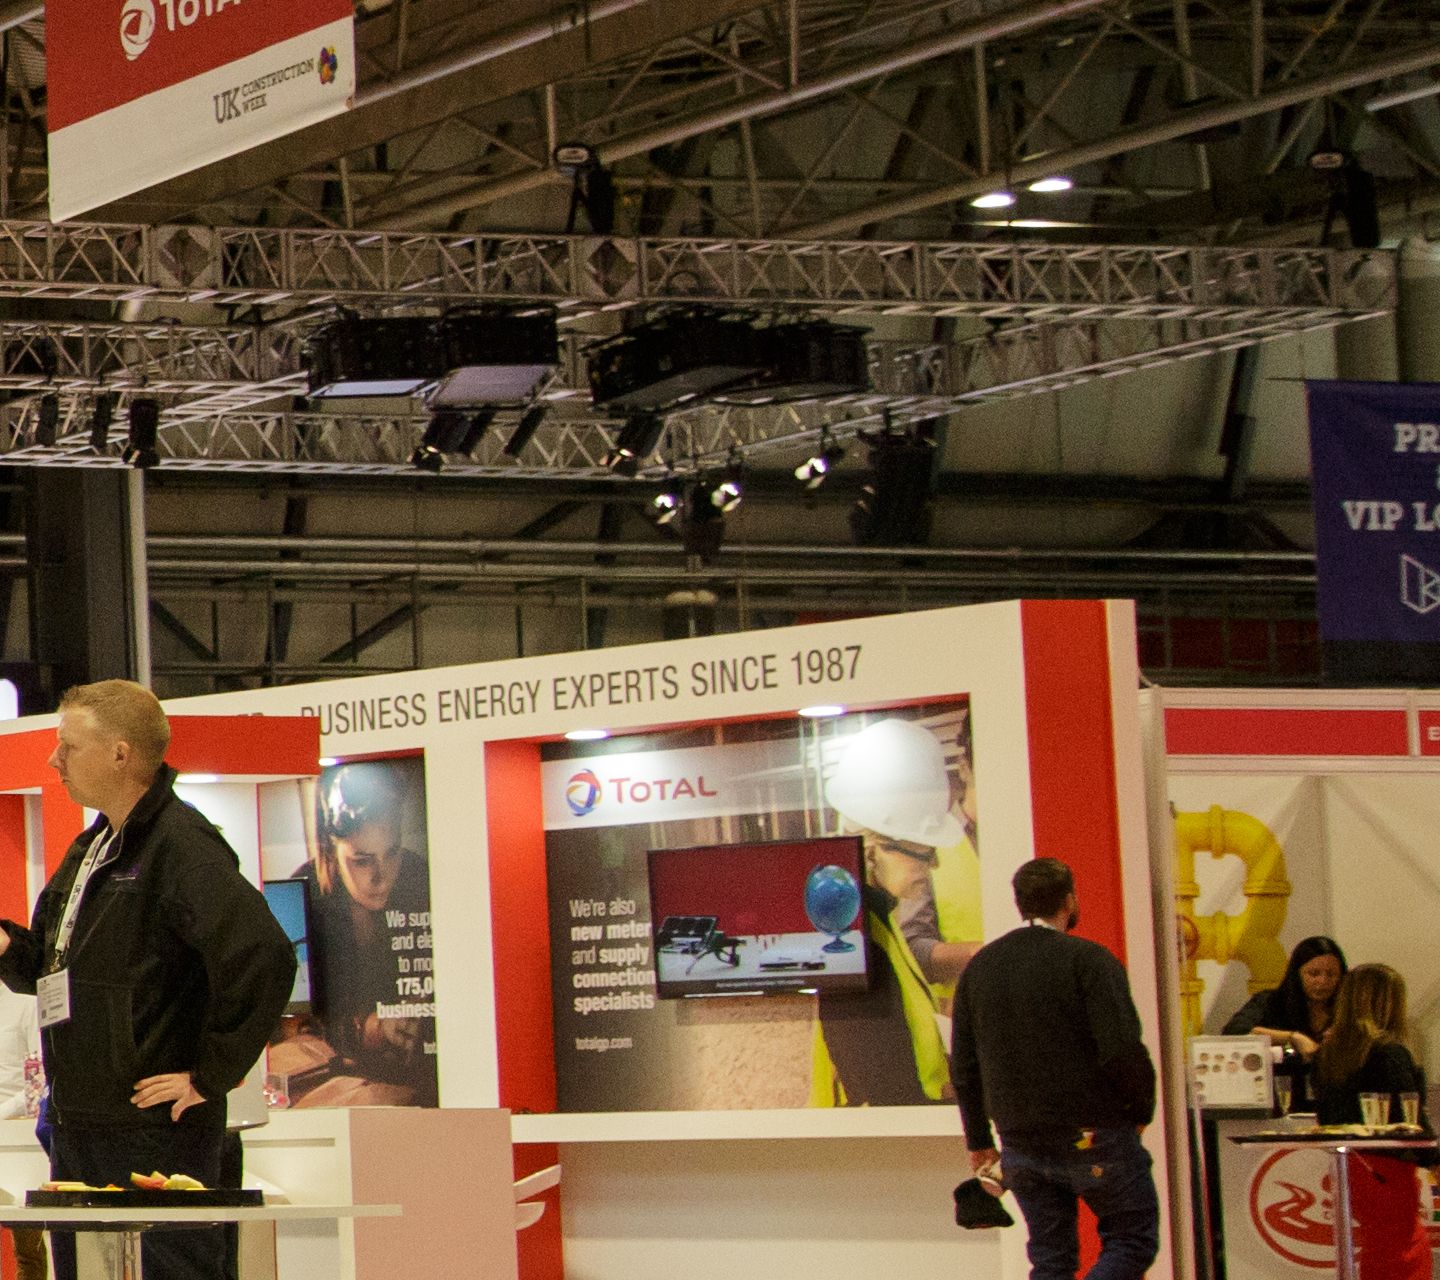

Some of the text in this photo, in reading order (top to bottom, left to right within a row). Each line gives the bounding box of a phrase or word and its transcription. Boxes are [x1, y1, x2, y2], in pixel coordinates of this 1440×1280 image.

[241, 58, 315, 98] CONSTRUCTION
[213, 87, 242, 124] UK
[242, 93, 268, 114] WEEK
[1342, 500, 1405, 532] VIP
[438, 679, 542, 724] ENERGY
[553, 665, 679, 711] EXPERTS
[691, 654, 778, 697] SINCE
[791, 645, 863, 686] 1987
[569, 896, 637, 918] We're also
[385, 910, 406, 928] We
[391, 931, 414, 951] and
[570, 920, 653, 942] new meter
[397, 955, 411, 973] to
[571, 943, 650, 967] and supply
[573, 967, 656, 989] connection
[574, 991, 655, 1016] specialists
